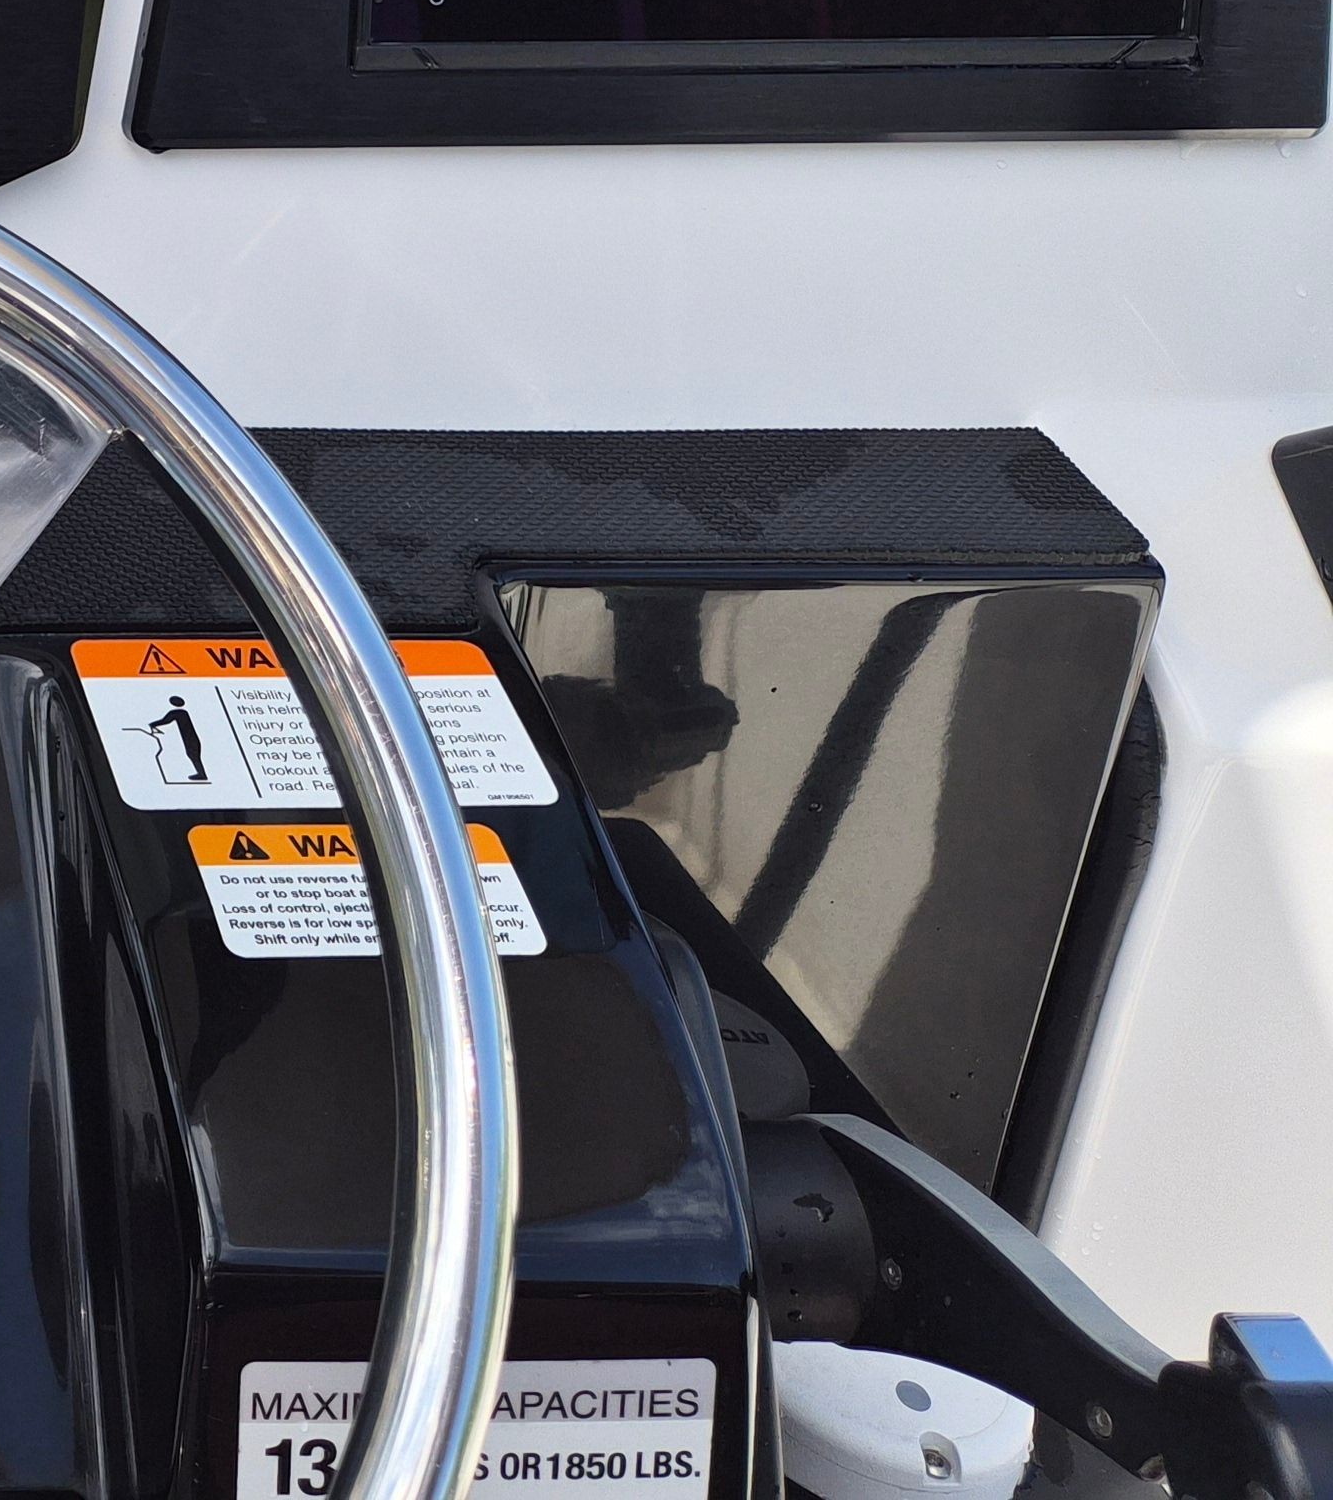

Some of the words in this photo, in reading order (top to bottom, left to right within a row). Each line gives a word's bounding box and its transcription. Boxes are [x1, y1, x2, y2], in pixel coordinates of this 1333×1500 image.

[230, 689, 292, 702] Visibility
[415, 687, 473, 700] position
[476, 688, 492, 698] at
[237, 705, 265, 715] this
[427, 703, 482, 713] serious
[243, 719, 285, 732] injury
[289, 721, 304, 730] or
[249, 734, 316, 747] Operatio
[448, 731, 507, 745] position
[256, 751, 288, 762] may
[292, 750, 312, 760] be
[441, 747, 482, 758] intain
[486, 748, 496, 758] a
[261, 764, 319, 776] lookout
[446, 762, 479, 774] ules
[483, 762, 495, 773] of
[500, 762, 525, 773] the
[268, 780, 309, 791] road.
[219, 875, 240, 885] Do
[243, 875, 266, 885] not
[269, 876, 294, 885] use
[297, 876, 348, 884] reverse
[256, 890, 270, 899] or
[273, 889, 288, 899] to
[291, 889, 321, 901] stop
[324, 888, 356, 898] boat
[221, 904, 256, 914] Loss
[260, 903, 273, 913] of
[277, 903, 331, 915] control,
[333, 903, 372, 915] ejecti
[489, 904, 524, 913] ccur.
[228, 919, 286, 929] Reverse
[289, 918, 302, 928] is
[305, 918, 324, 929] for
[328, 918, 352, 928] low
[495, 918, 529, 930] only.
[254, 934, 288, 945] Shift
[290, 934, 324, 946] only
[324, 933, 361, 944] while
[251, 1392, 362, 1420] MAXI
[490, 1388, 700, 1420] APACITIES
[265, 1438, 338, 1496] 13
[635, 1450, 701, 1479] LBS.
